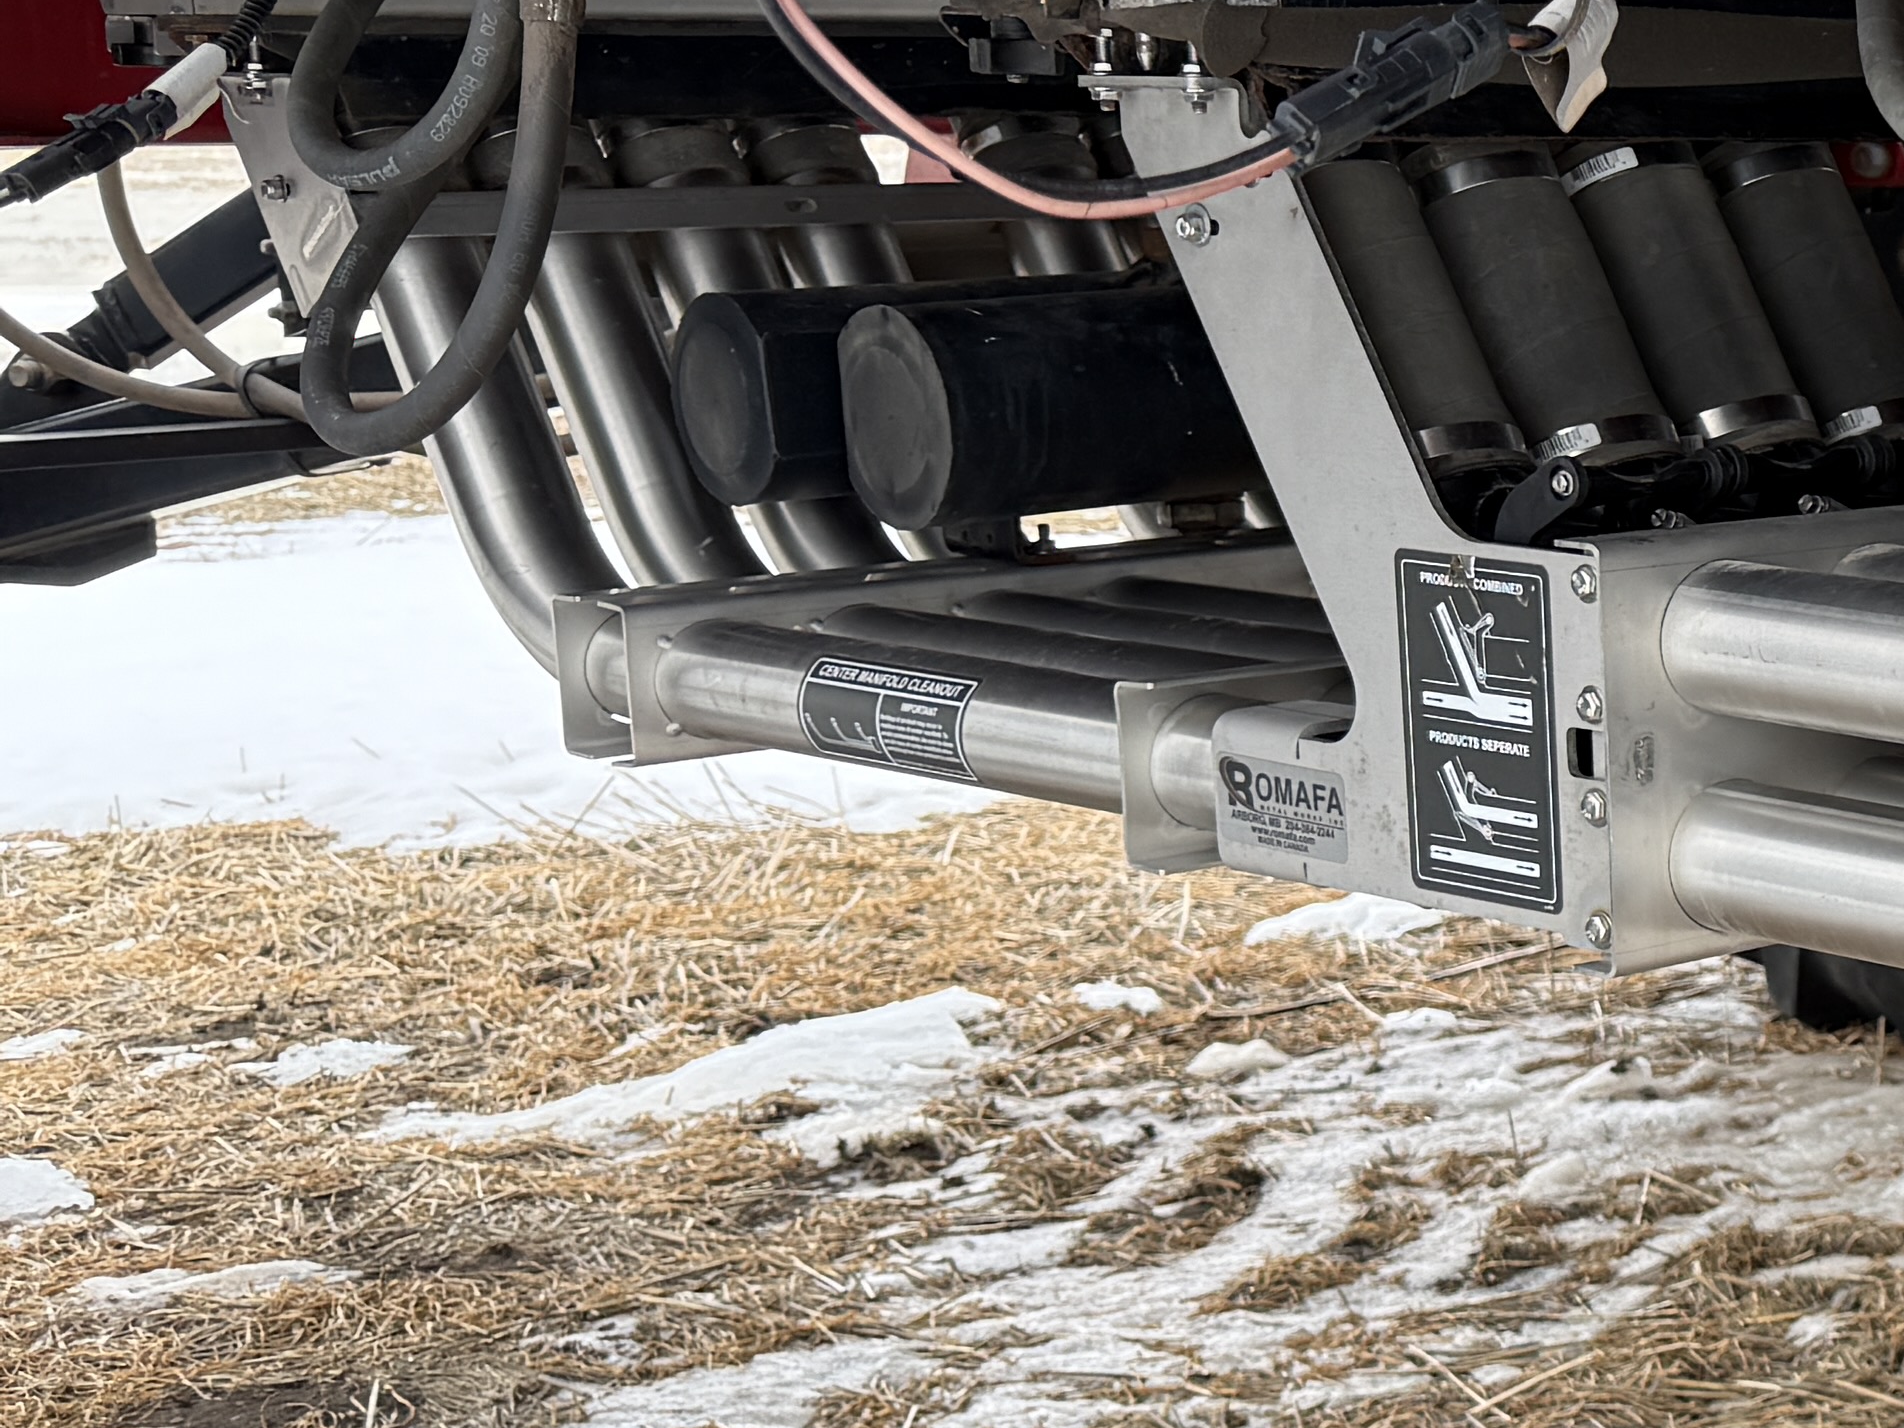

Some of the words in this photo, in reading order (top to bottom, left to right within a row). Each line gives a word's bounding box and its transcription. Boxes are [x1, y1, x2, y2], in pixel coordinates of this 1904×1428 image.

[1473, 579, 1524, 596] COMBINED
[819, 664, 856, 681] CENTER
[857, 669, 906, 688] MANIFOLD
[907, 677, 965, 698] CLEANOUT
[1429, 729, 1480, 750] PRODUCTS
[1481, 736, 1530, 758] SEPERATE
[1219, 756, 1344, 817] ROMAFA
